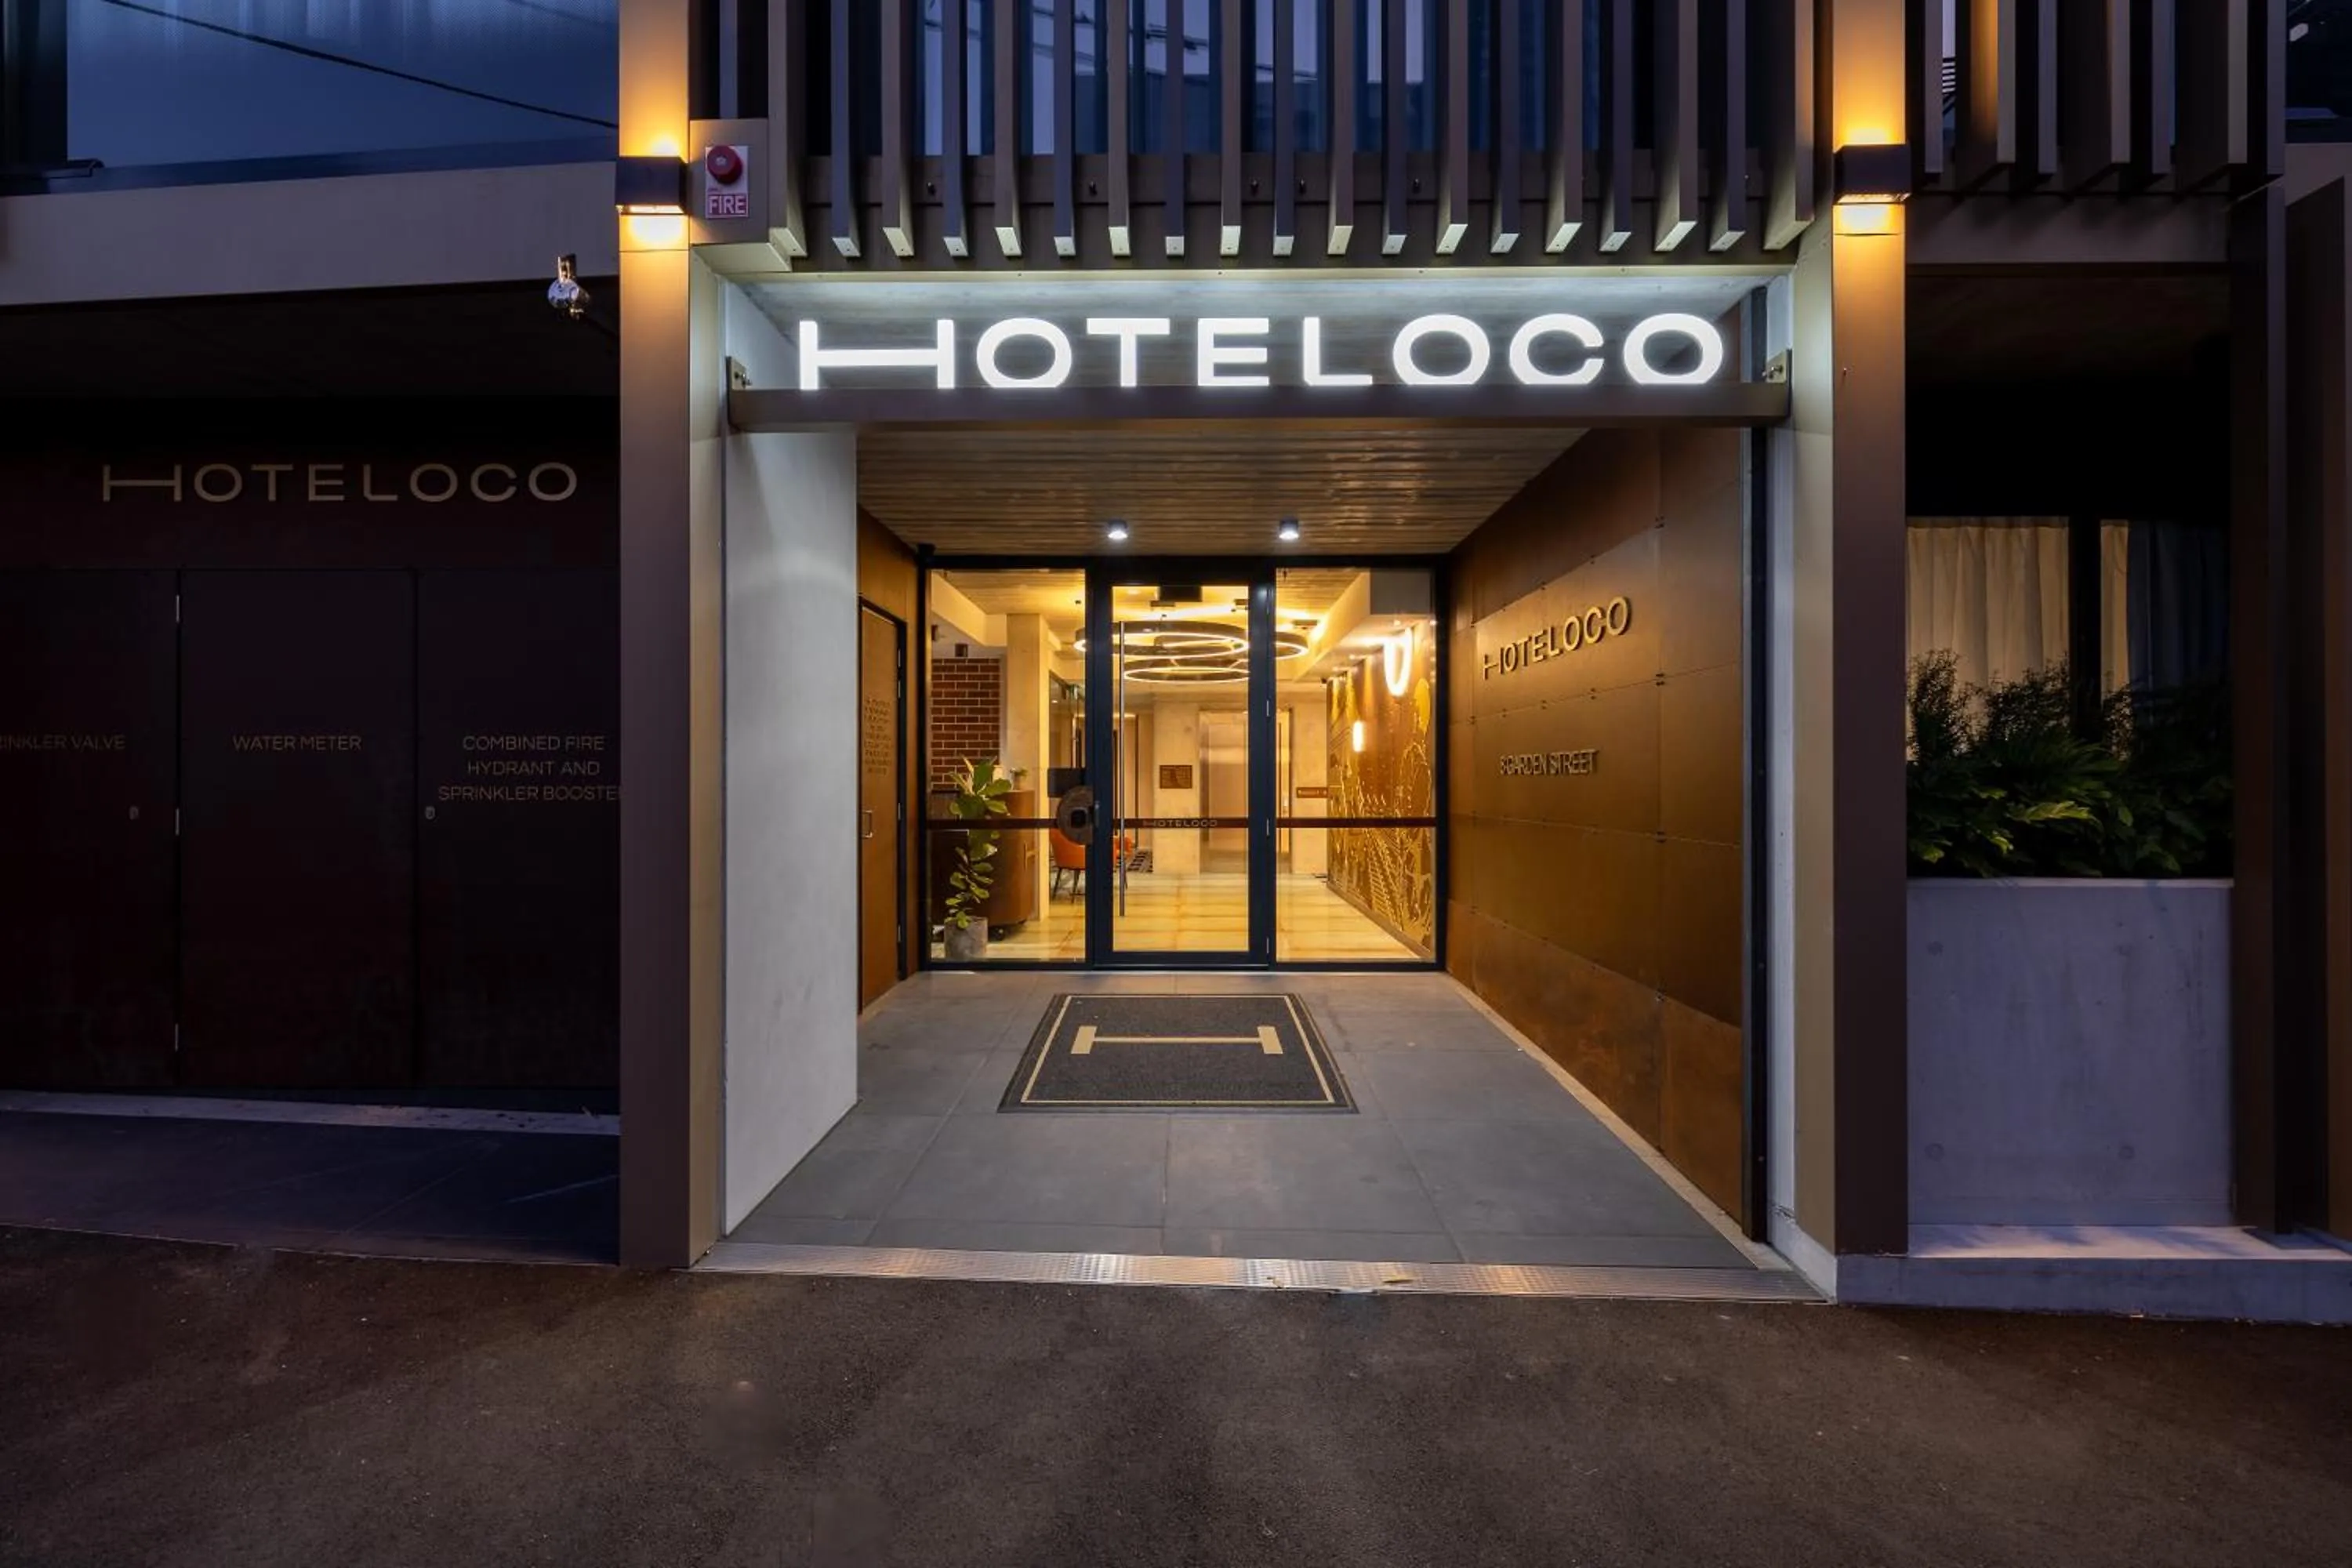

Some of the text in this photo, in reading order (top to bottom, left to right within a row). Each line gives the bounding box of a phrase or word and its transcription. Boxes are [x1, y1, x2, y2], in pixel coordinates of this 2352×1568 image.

[709, 195, 746, 214] FIRE
[799, 314, 1725, 390] HOTELOCO
[102, 461, 579, 503] HOTELOCO
[1483, 596, 1631, 681] HOTELOCO
[0, 734, 126, 750] INKLER VALVE
[232, 735, 362, 751] WATER METER
[463, 735, 605, 750] COMBINED FIRE
[467, 760, 601, 776] HYDRANT AND
[1506, 753, 1547, 775] GARDEN
[1549, 749, 1596, 774] STREET
[437, 785, 621, 801] SPRINKLER BOOSTE
